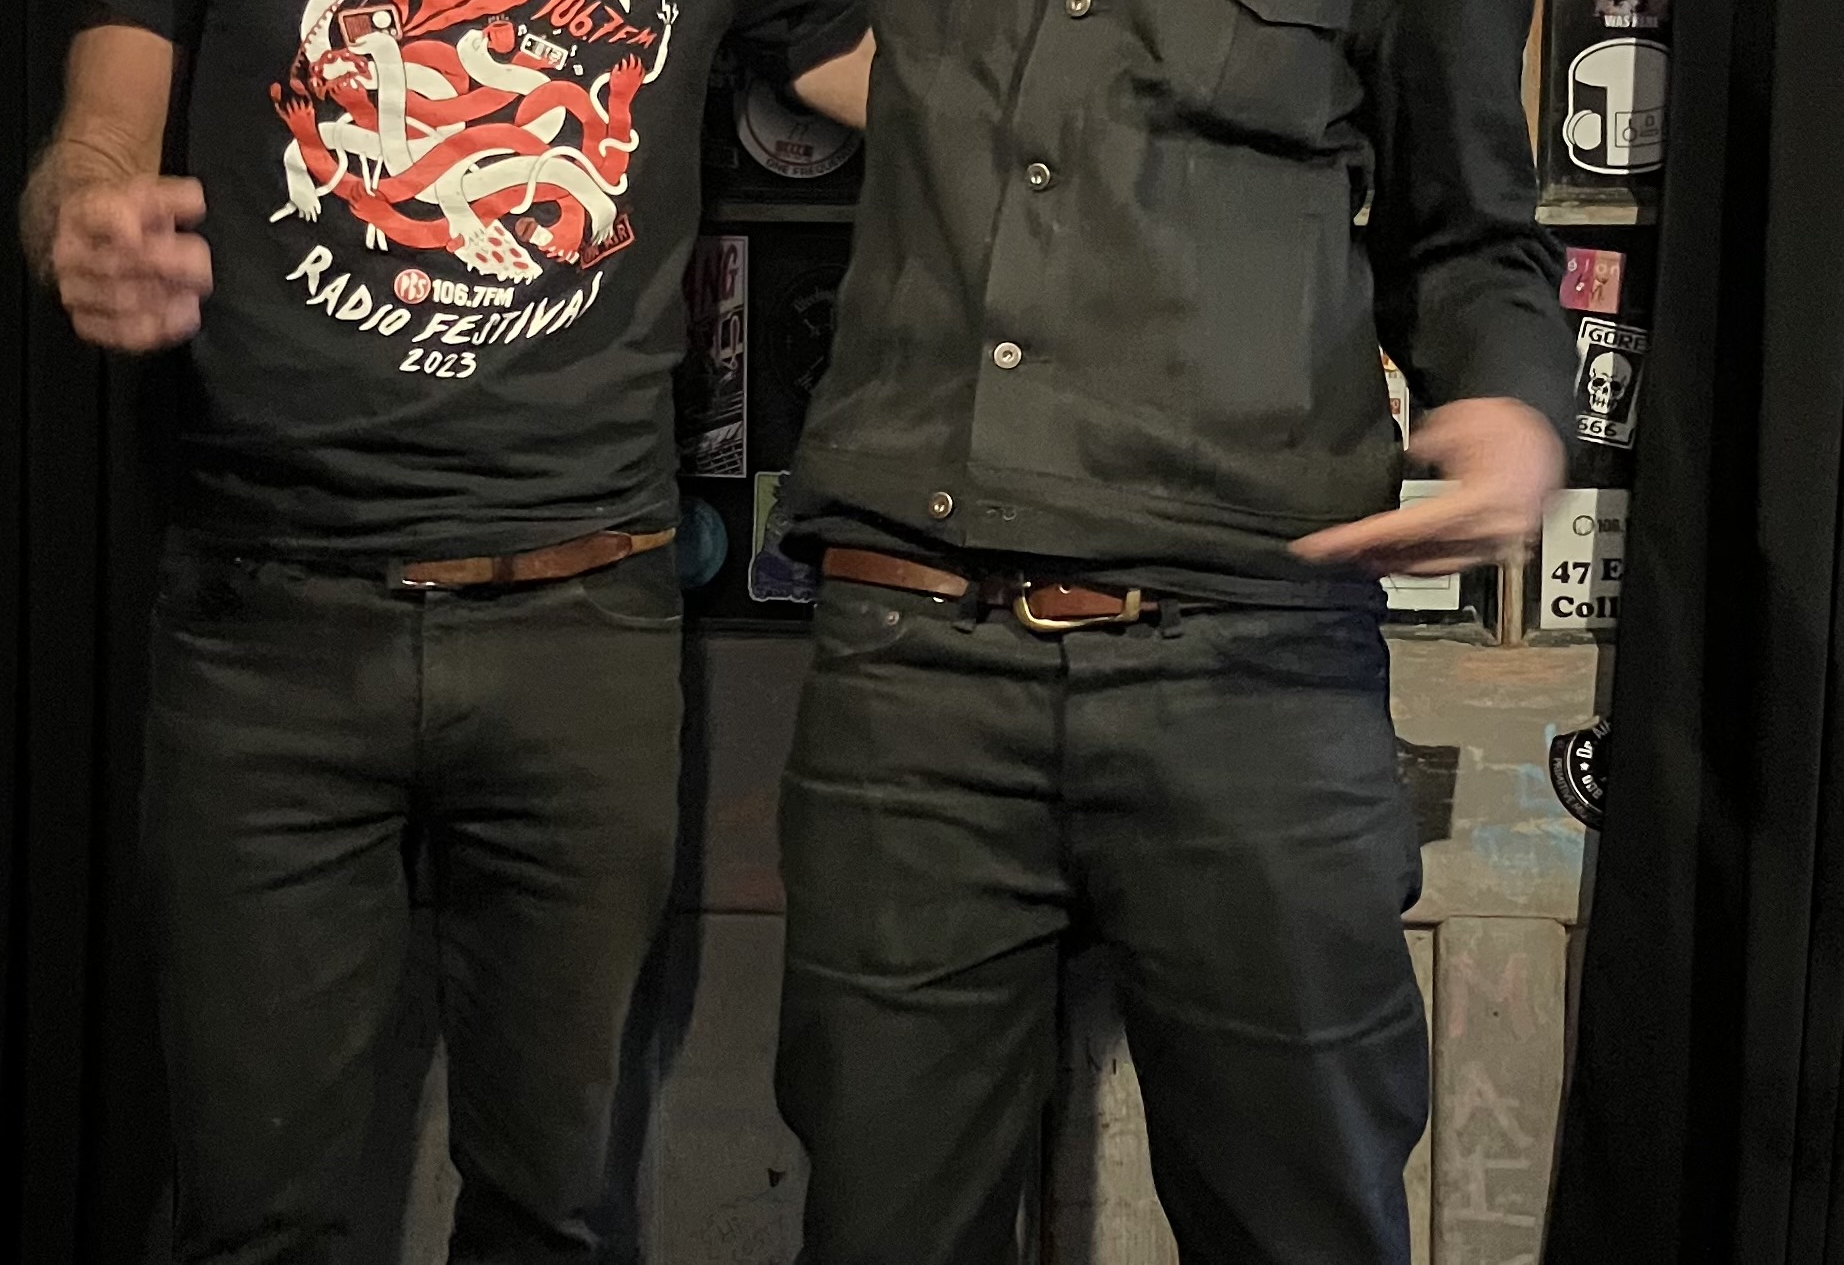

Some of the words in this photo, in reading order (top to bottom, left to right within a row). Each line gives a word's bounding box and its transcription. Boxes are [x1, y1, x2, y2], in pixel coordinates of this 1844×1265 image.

[1604, 15, 1630, 27] WAS
[286, 243, 410, 338] RADIO
[399, 271, 428, 300] PBS
[432, 278, 515, 308] 106.7FM
[1588, 328, 1649, 352] GORE
[399, 349, 478, 379] 2023
[1577, 418, 1617, 436] 666
[1551, 561, 1591, 584] 47
